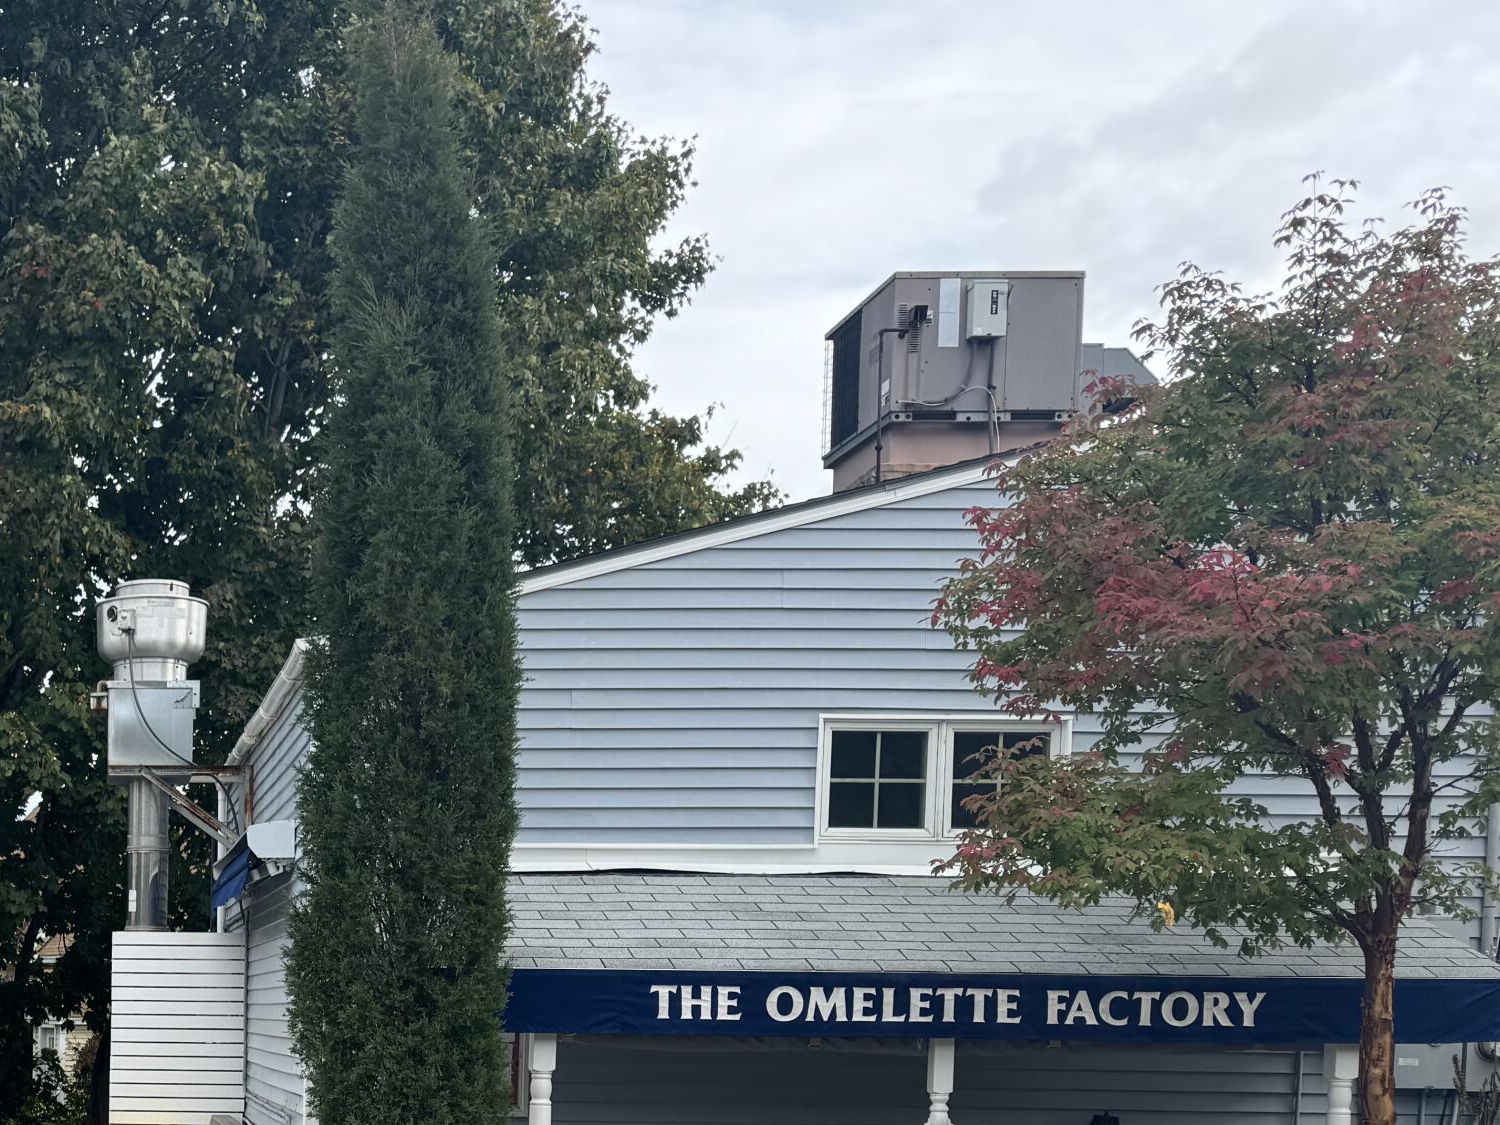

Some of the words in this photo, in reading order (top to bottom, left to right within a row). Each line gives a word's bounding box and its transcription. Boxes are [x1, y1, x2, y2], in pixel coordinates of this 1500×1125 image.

[650, 985, 742, 1021] THE
[766, 985, 1022, 1024] OMELETTE
[1046, 989, 1267, 1027] FACTORY
